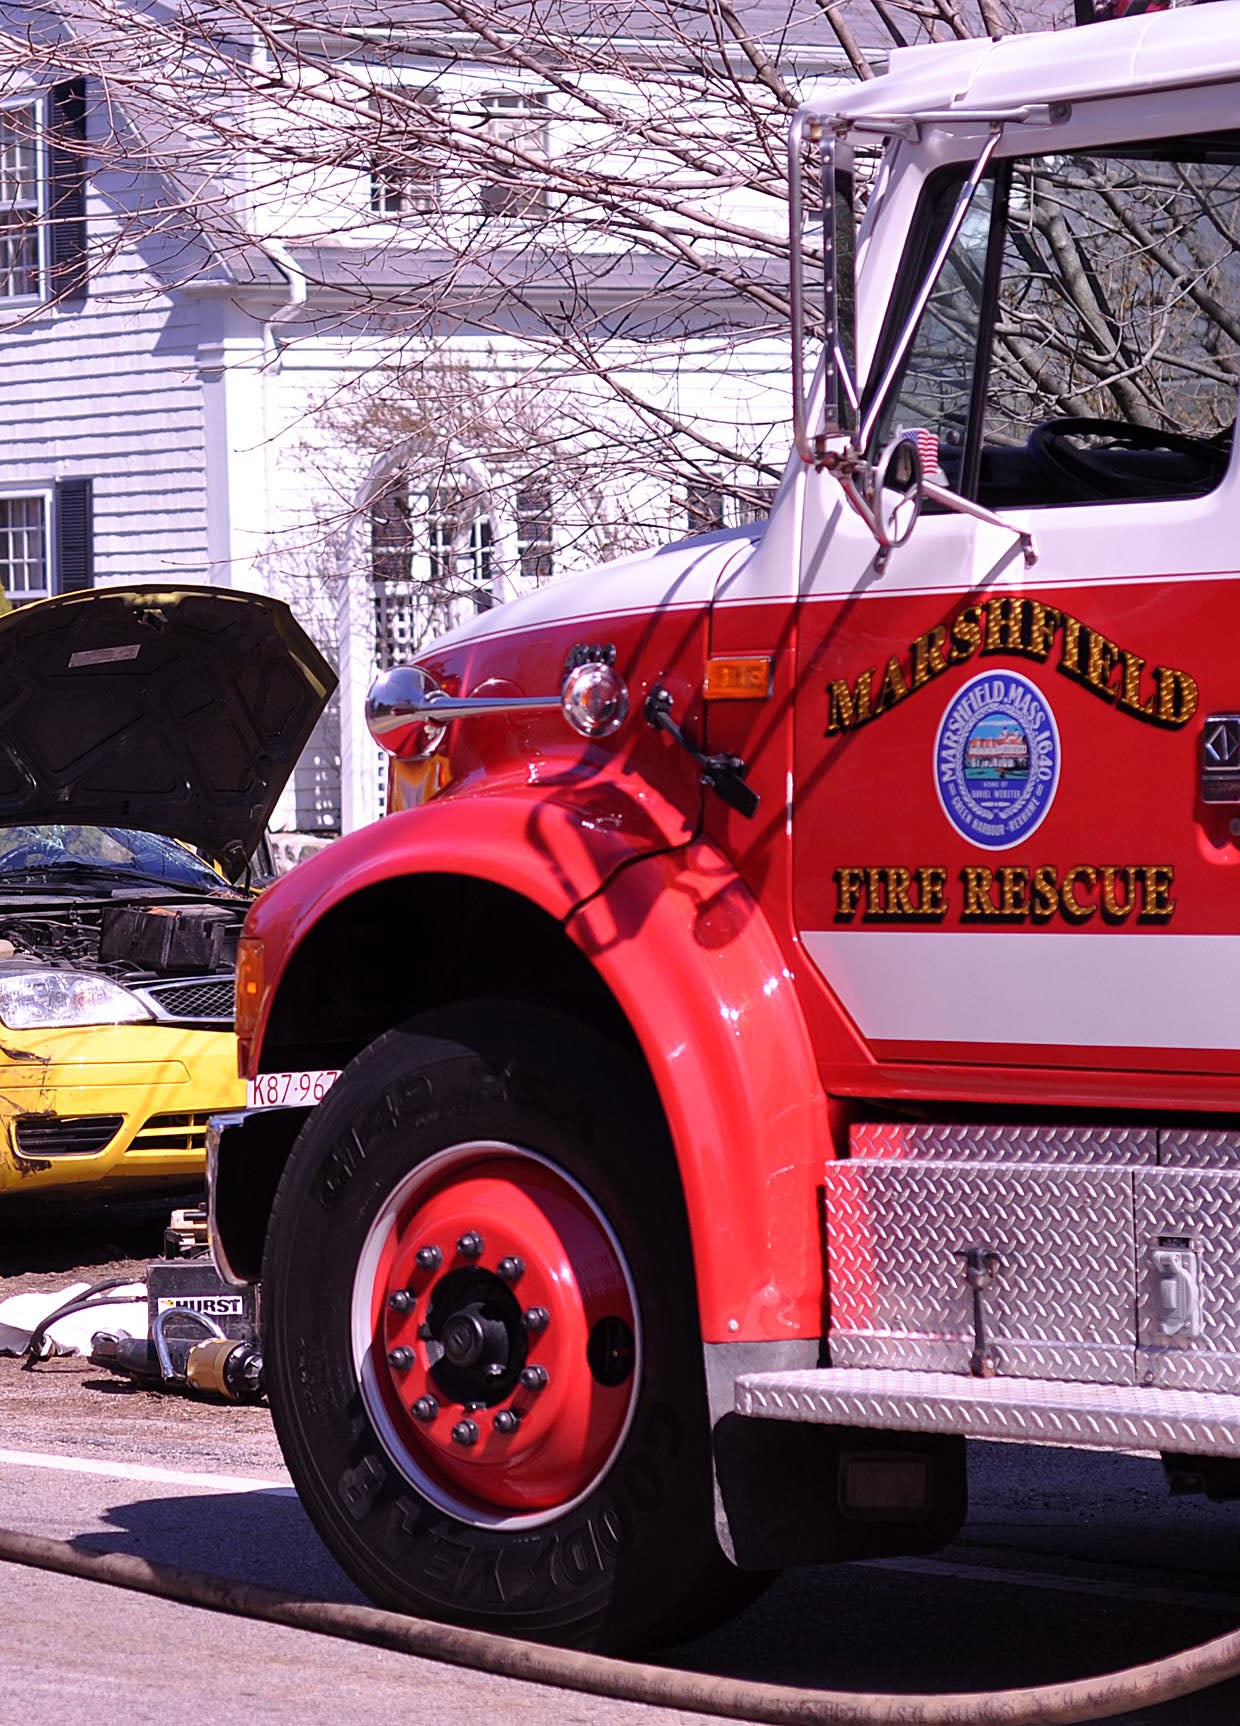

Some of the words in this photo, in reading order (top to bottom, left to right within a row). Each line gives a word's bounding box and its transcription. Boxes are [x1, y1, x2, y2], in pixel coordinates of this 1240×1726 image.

[825, 597, 1200, 737] MARSHFIELD
[833, 865, 949, 924] FIRE
[959, 864, 1178, 926] RESCUE
